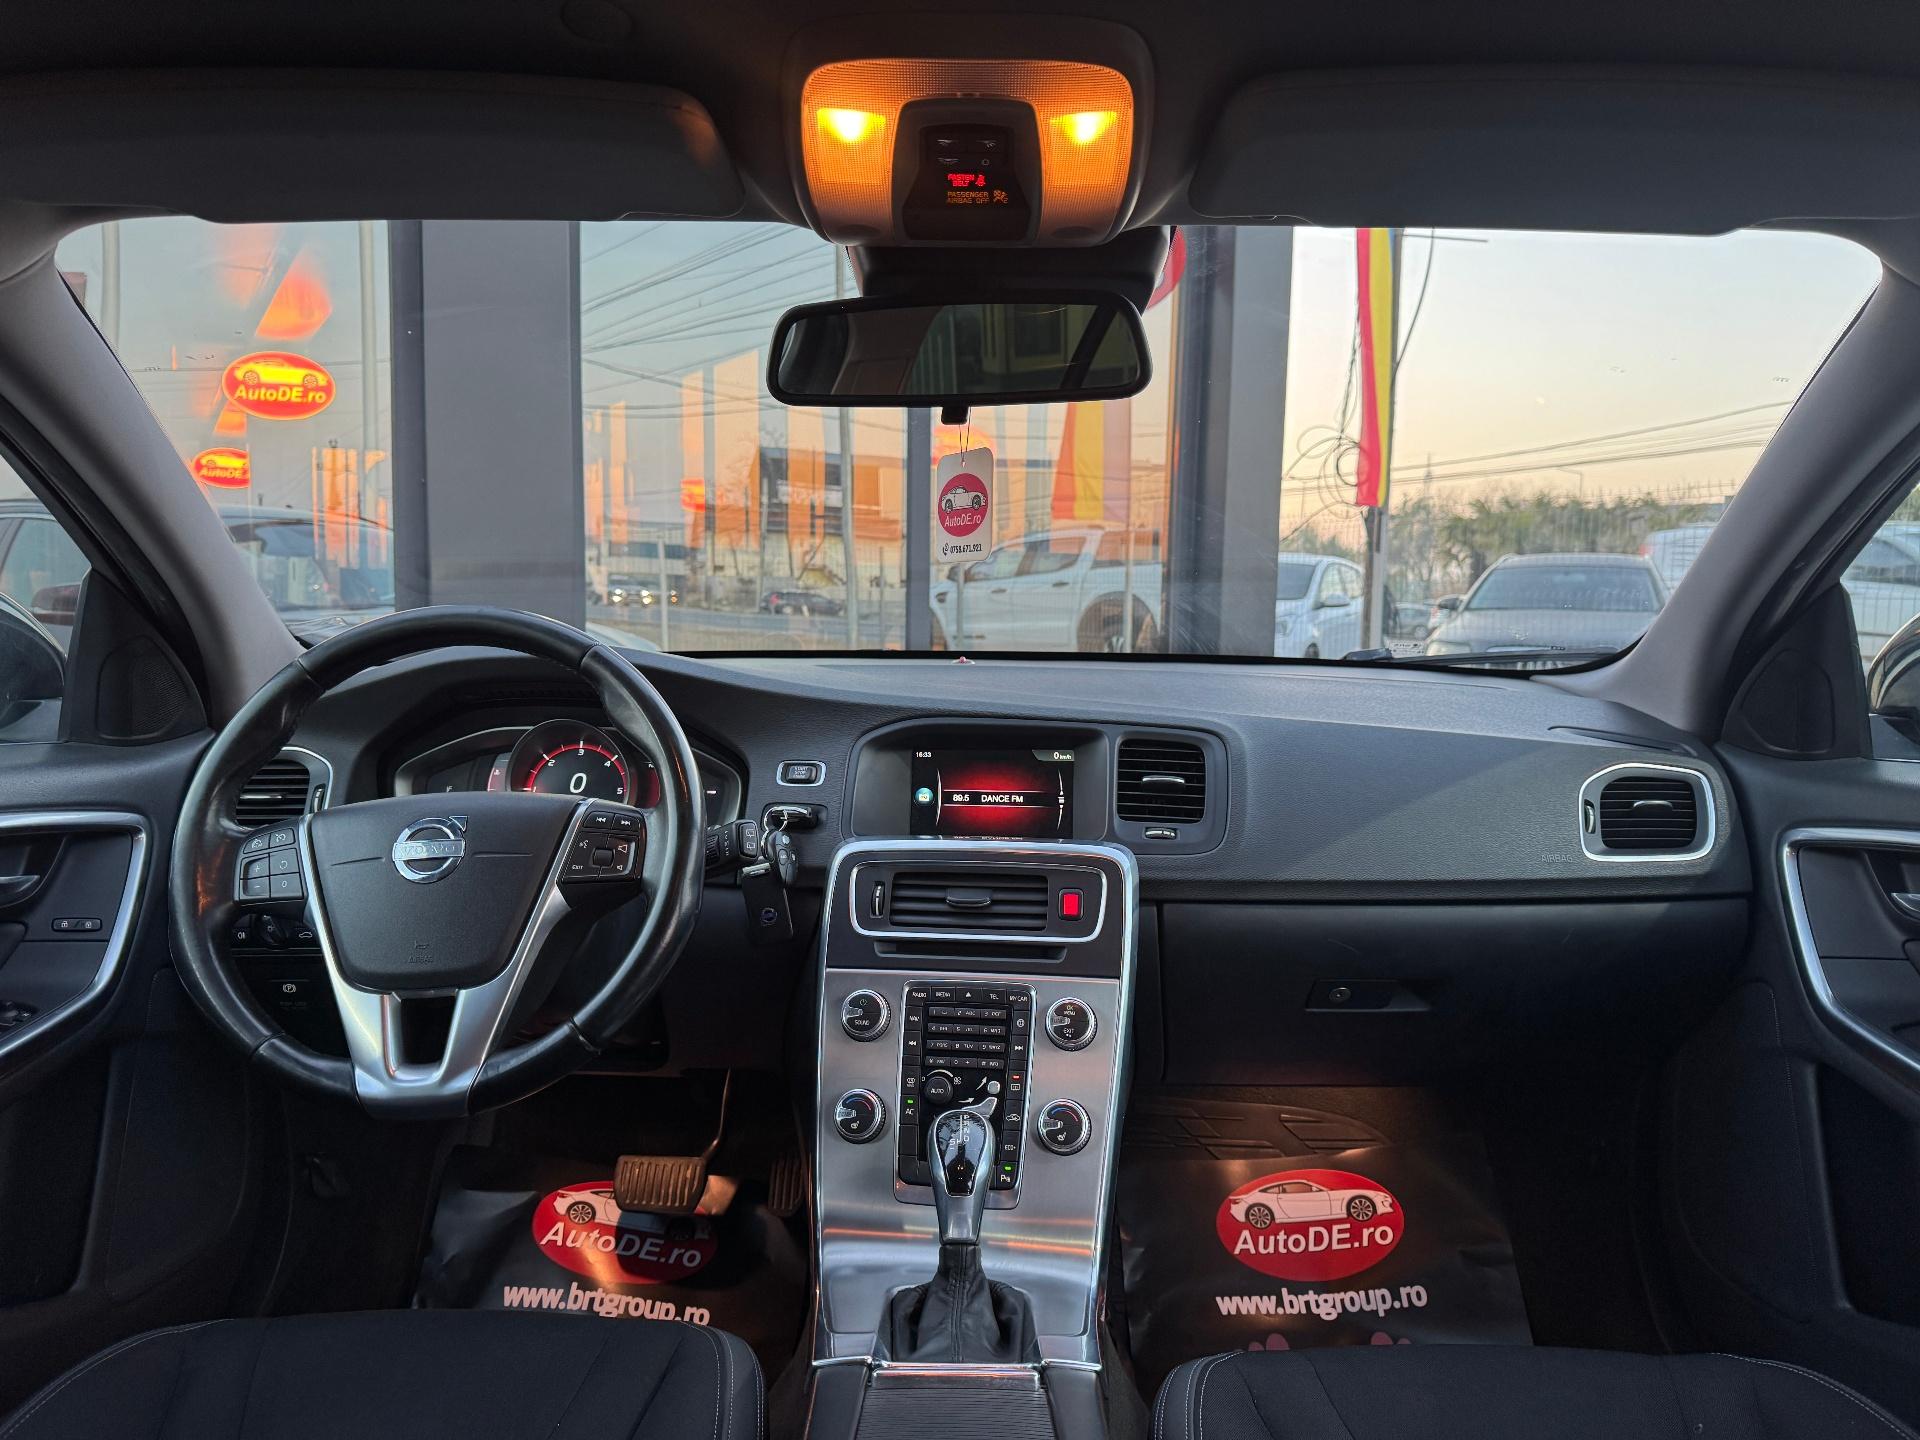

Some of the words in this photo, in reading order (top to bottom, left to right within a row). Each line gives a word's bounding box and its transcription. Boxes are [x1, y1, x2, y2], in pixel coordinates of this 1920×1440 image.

[234, 384, 327, 404] AutoDE.ro
[944, 513, 982, 527] AutoDE.ro
[548, 758, 556, 767] 2
[1053, 751, 1060, 760] 0
[569, 772, 588, 794] 0
[616, 787, 624, 795] 5
[952, 793, 970, 802] 89.5
[981, 794, 1009, 803] DANCE
[1011, 795, 1024, 803] FM
[1540, 854, 1573, 863] AIRBAG
[539, 1221, 702, 1268] AutoDE.ro
[1233, 1223, 1394, 1255] AutoDE.ro
[503, 1281, 711, 1326] www.brtgroup.ro
[1216, 1284, 1428, 1321] www.brtgroup.ro
